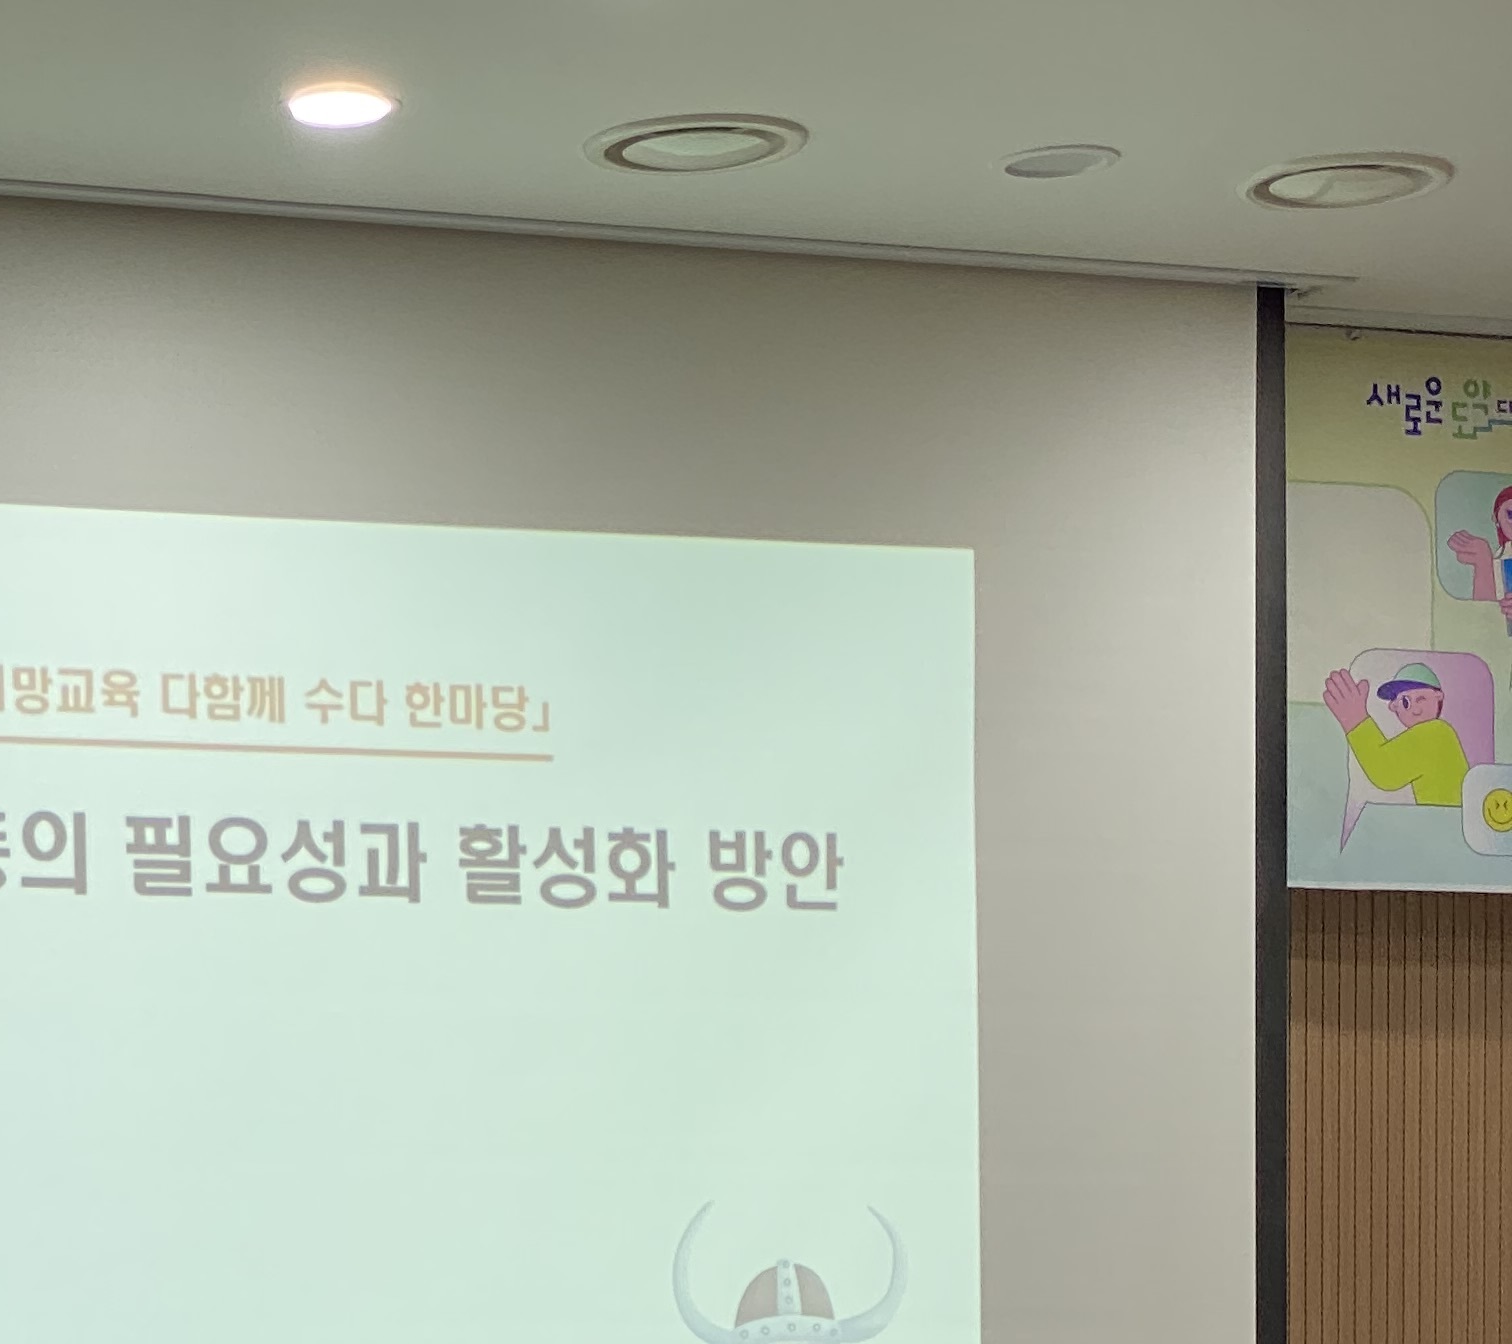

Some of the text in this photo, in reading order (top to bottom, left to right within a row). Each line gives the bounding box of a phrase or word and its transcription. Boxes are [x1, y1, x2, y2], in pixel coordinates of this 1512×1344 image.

[1366, 376, 1442, 436] 새로운
[161, 672, 286, 724] 다함께
[304, 677, 389, 727] 수다
[125, 814, 428, 904] 필요성과
[458, 823, 676, 910] 활성화
[708, 829, 845, 913] 방안
